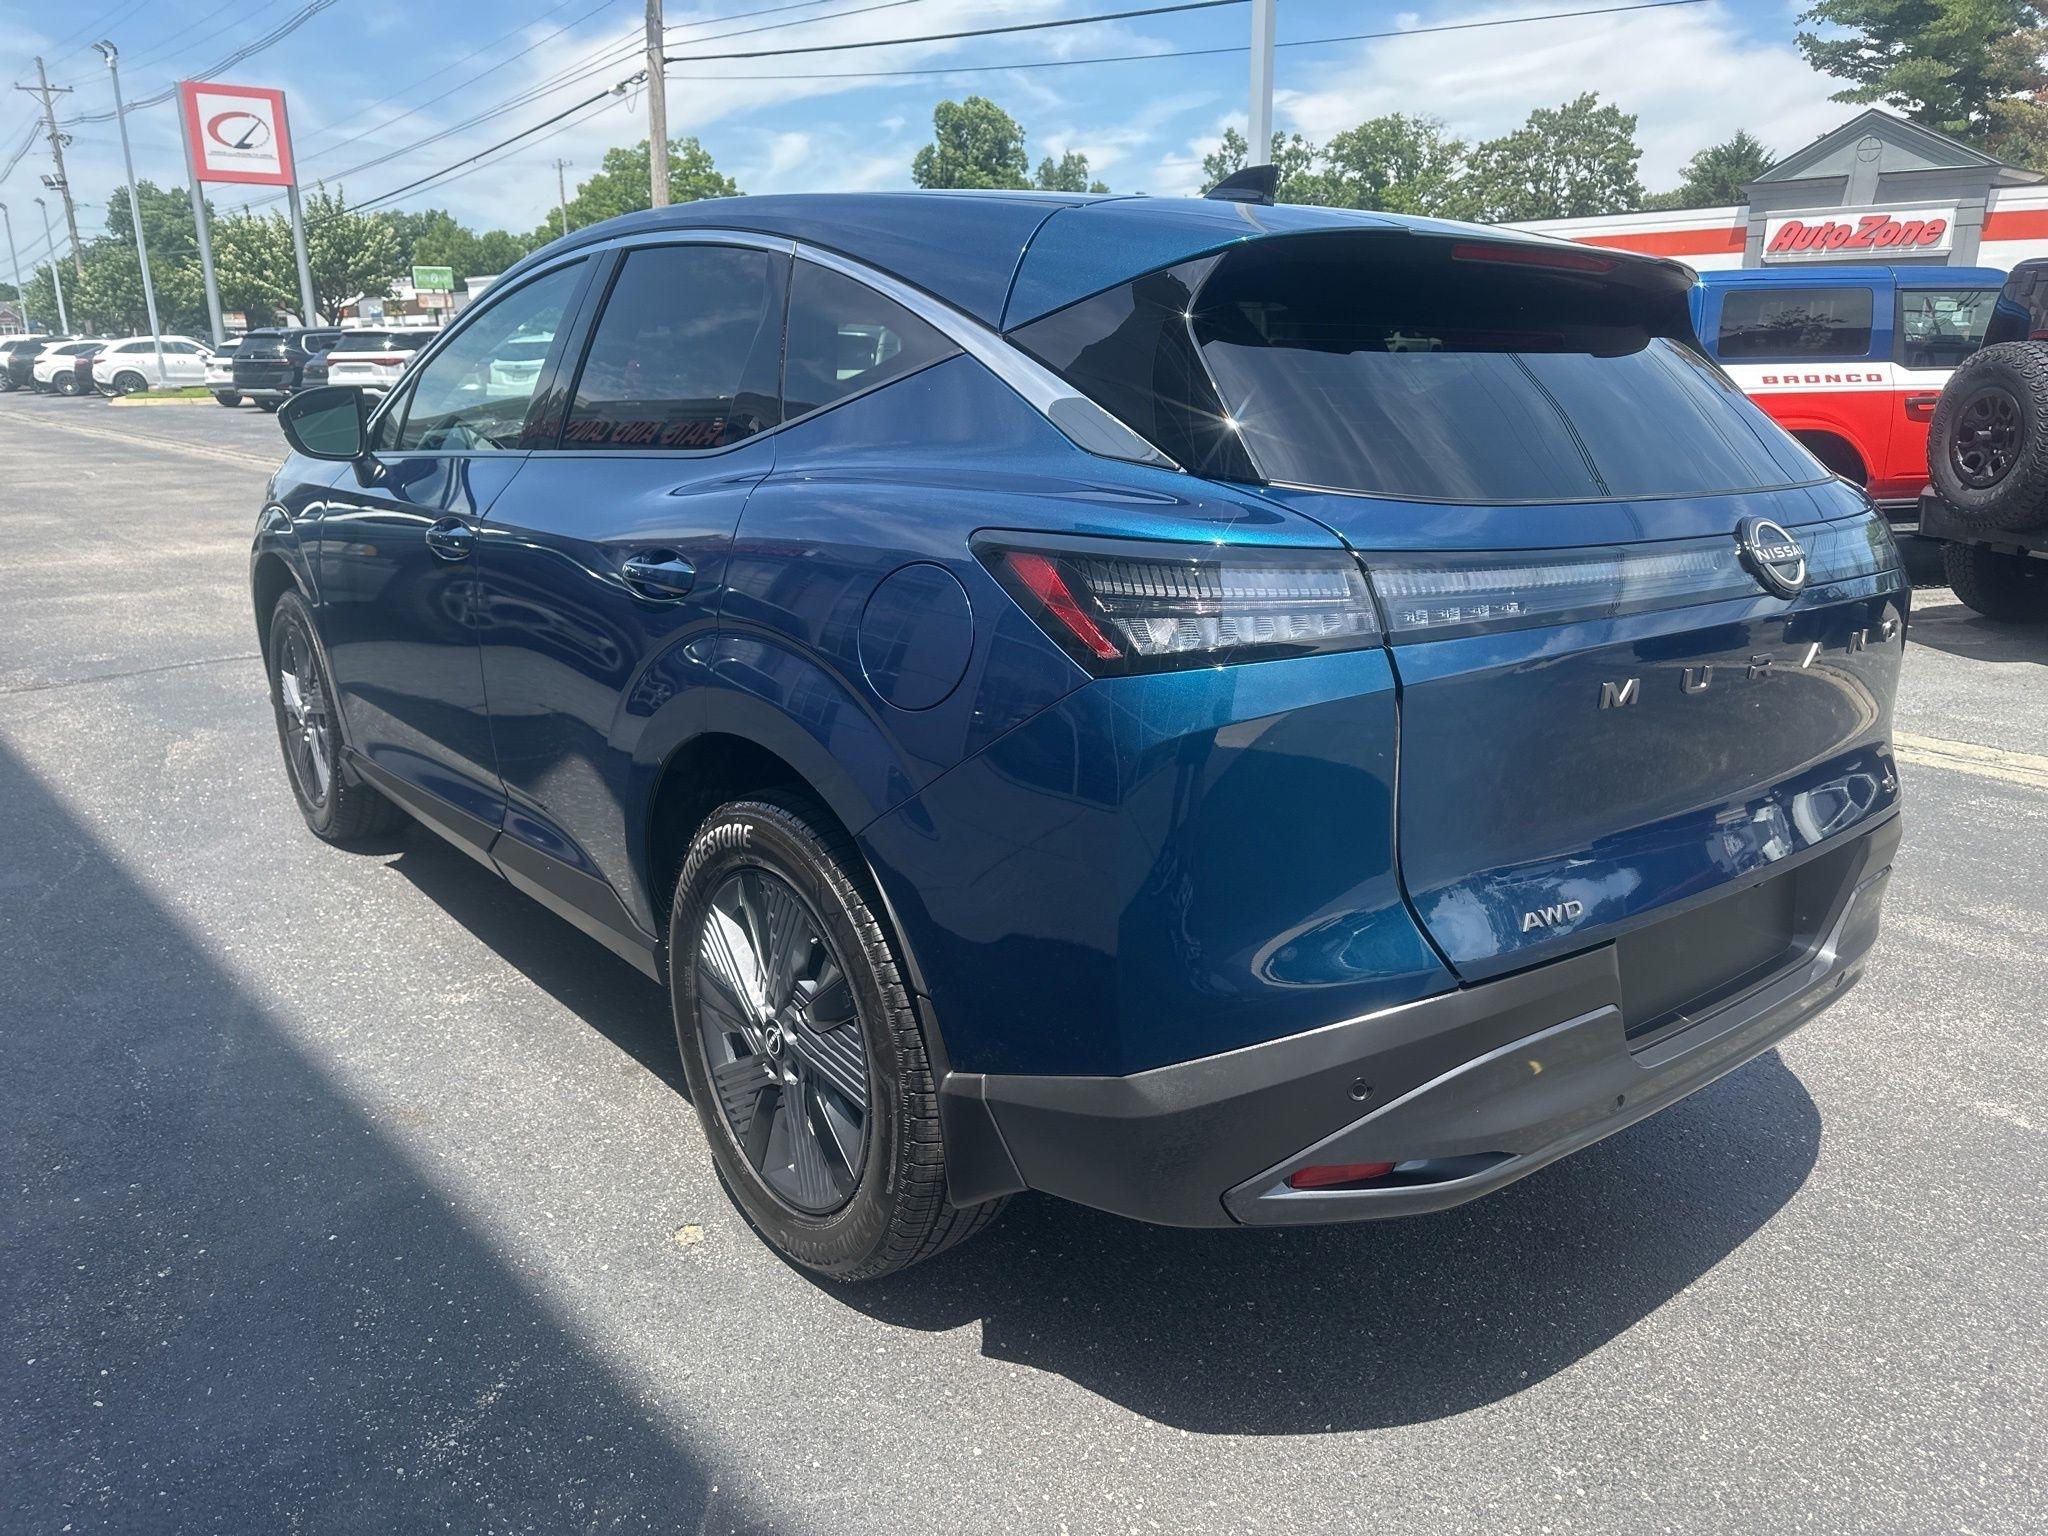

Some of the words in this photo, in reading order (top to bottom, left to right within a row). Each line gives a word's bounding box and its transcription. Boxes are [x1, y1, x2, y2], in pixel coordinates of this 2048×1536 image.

[1766, 215, 1948, 253] AutoZone
[1761, 373, 1883, 385] BRONCO
[1756, 544, 1805, 561] NISSAN
[1600, 618, 1898, 709] MURANO
[1522, 900, 1584, 933] AWD
